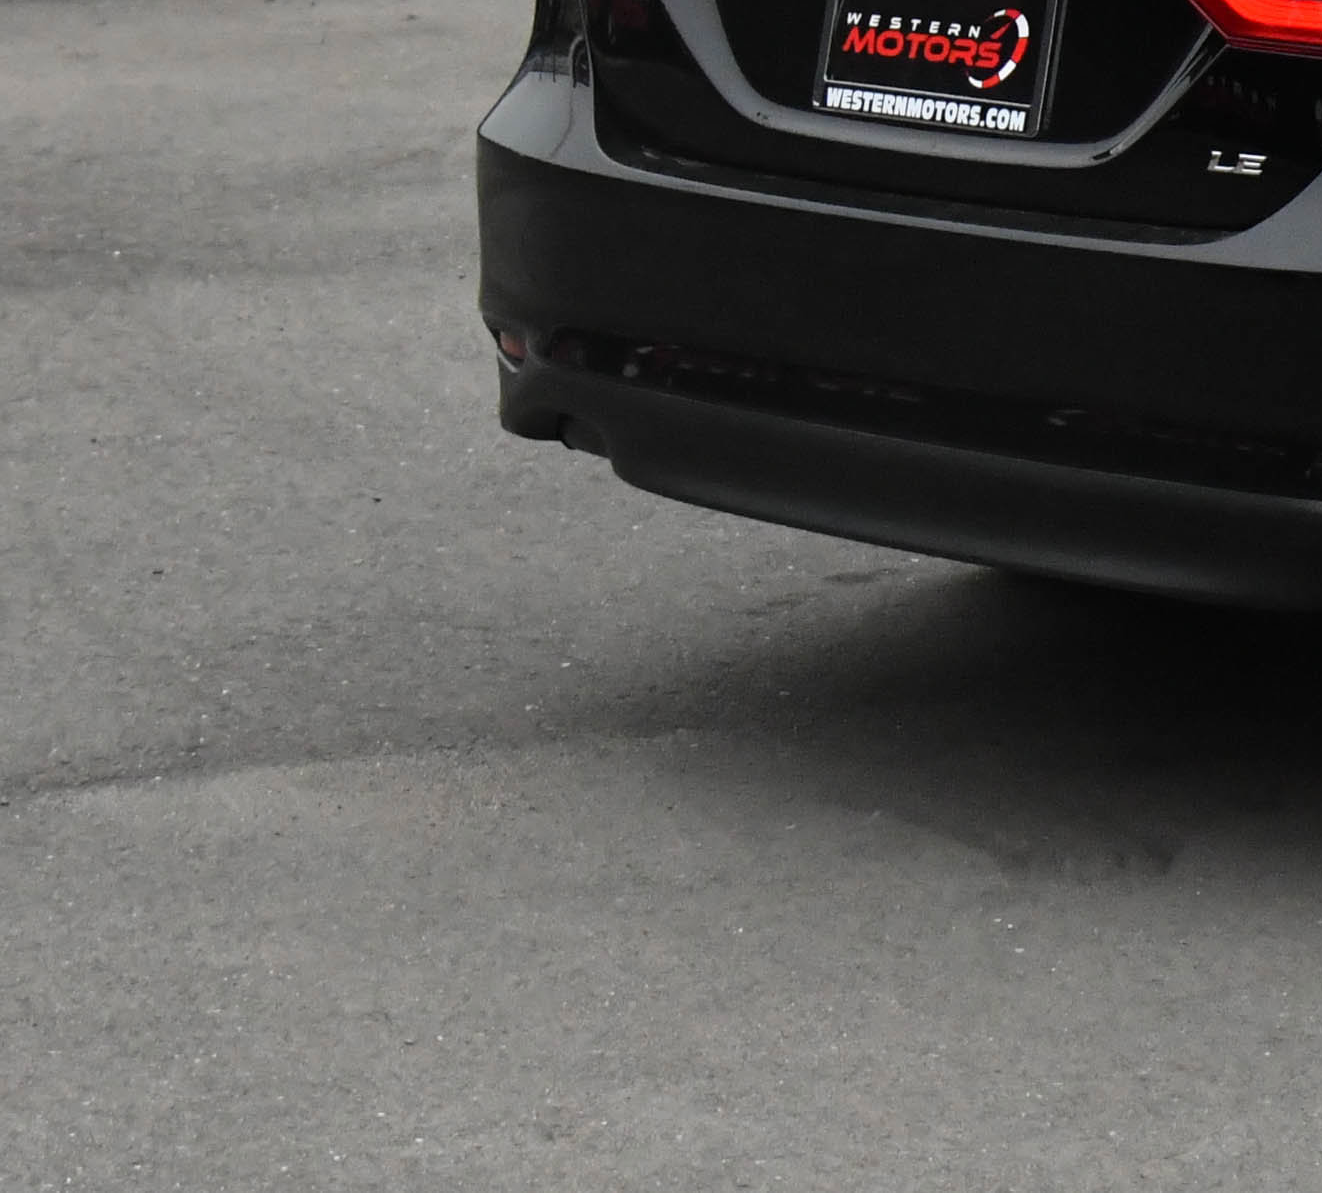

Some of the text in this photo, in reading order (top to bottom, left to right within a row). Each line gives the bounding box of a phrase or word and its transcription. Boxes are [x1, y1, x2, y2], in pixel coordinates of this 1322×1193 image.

[846, 12, 982, 39] WESTERN
[842, 25, 1003, 69] MOTORS
[826, 86, 1026, 132] WESTERNMOTORS.COM
[1207, 150, 1267, 175] LE
